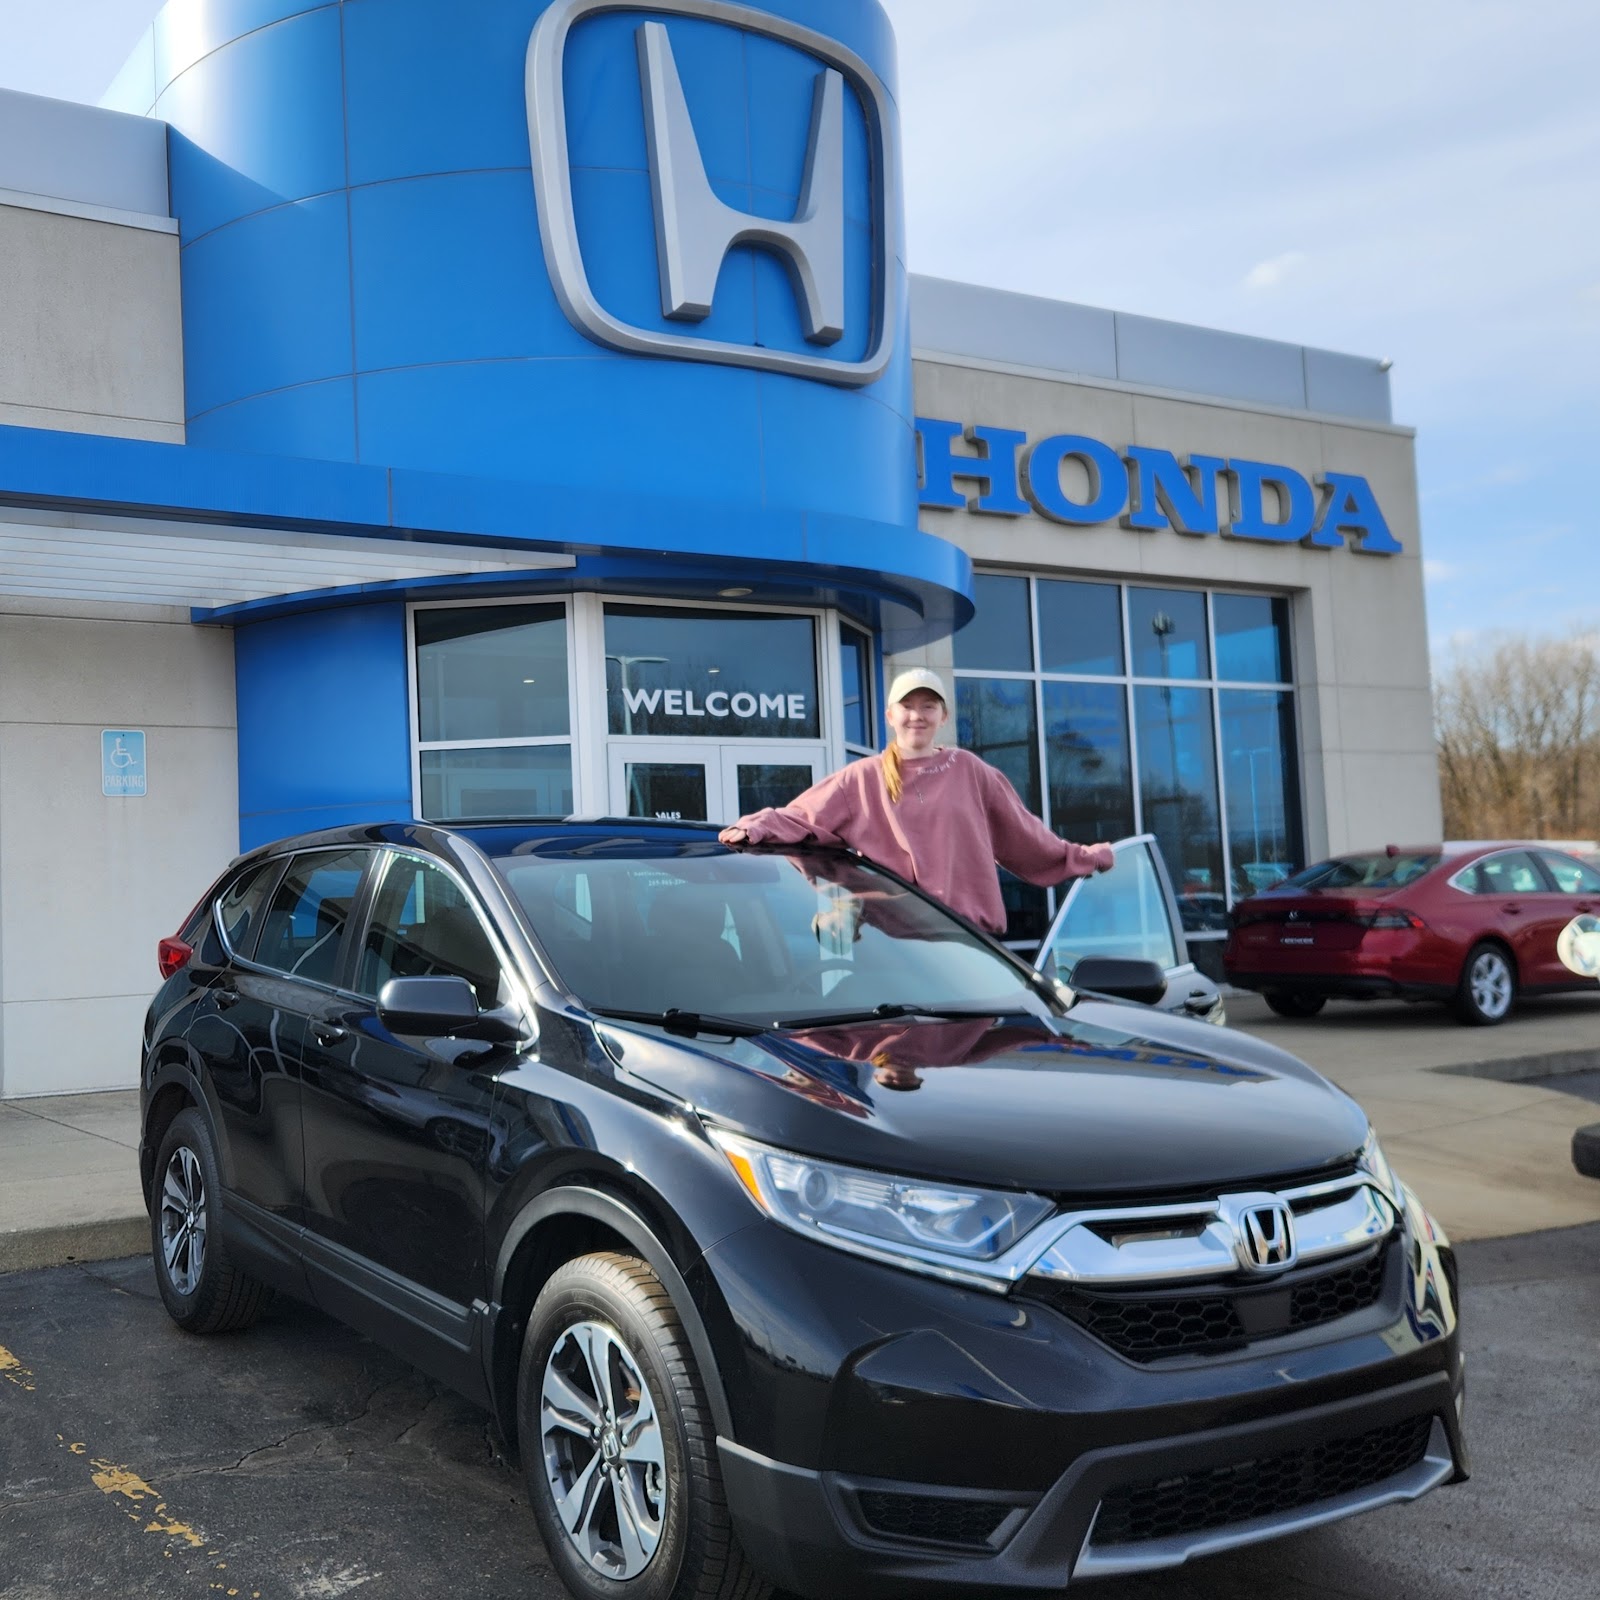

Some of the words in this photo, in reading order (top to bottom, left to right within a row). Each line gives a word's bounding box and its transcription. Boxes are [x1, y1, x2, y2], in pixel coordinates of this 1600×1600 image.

[914, 416, 1403, 555] HONDA
[622, 688, 806, 720] WELCOME
[104, 775, 145, 788] PARKING
[655, 811, 681, 820] SALES
